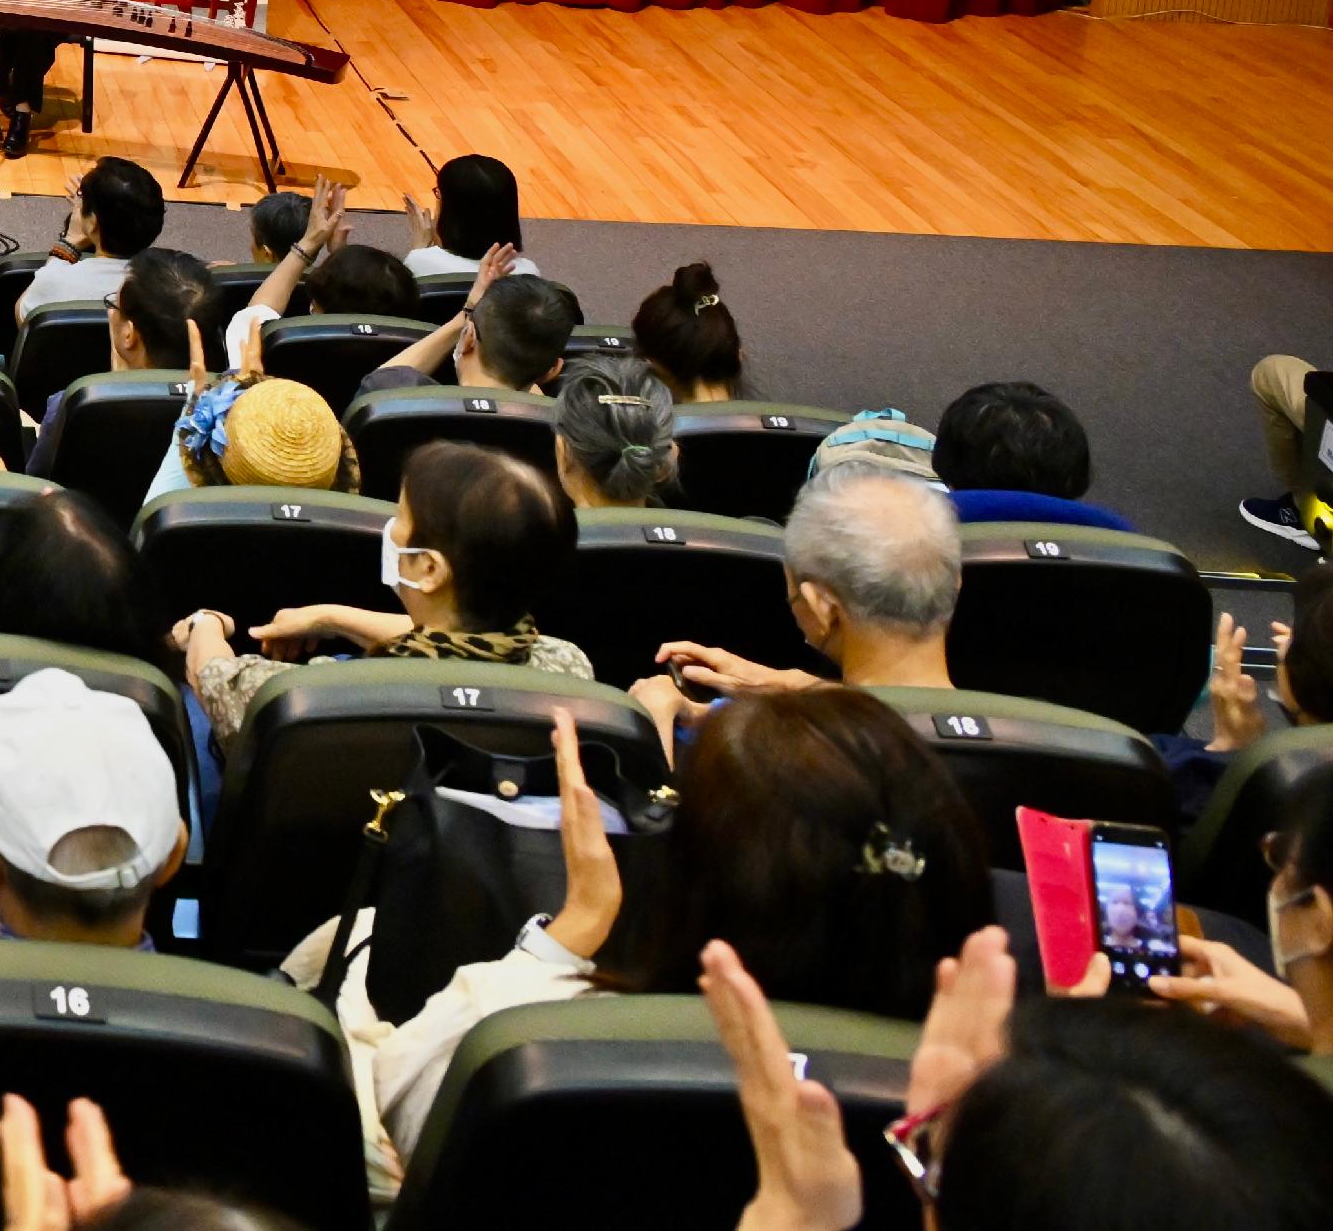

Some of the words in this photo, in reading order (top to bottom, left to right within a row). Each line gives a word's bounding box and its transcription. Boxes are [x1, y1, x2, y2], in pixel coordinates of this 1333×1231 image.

[770, 417, 788, 426] 19
[281, 505, 301, 517] 17
[653, 528, 676, 540] 18
[1036, 542, 1058, 555] 19
[453, 688, 479, 705] 17
[948, 717, 979, 735] 18
[51, 987, 89, 1015] 16
